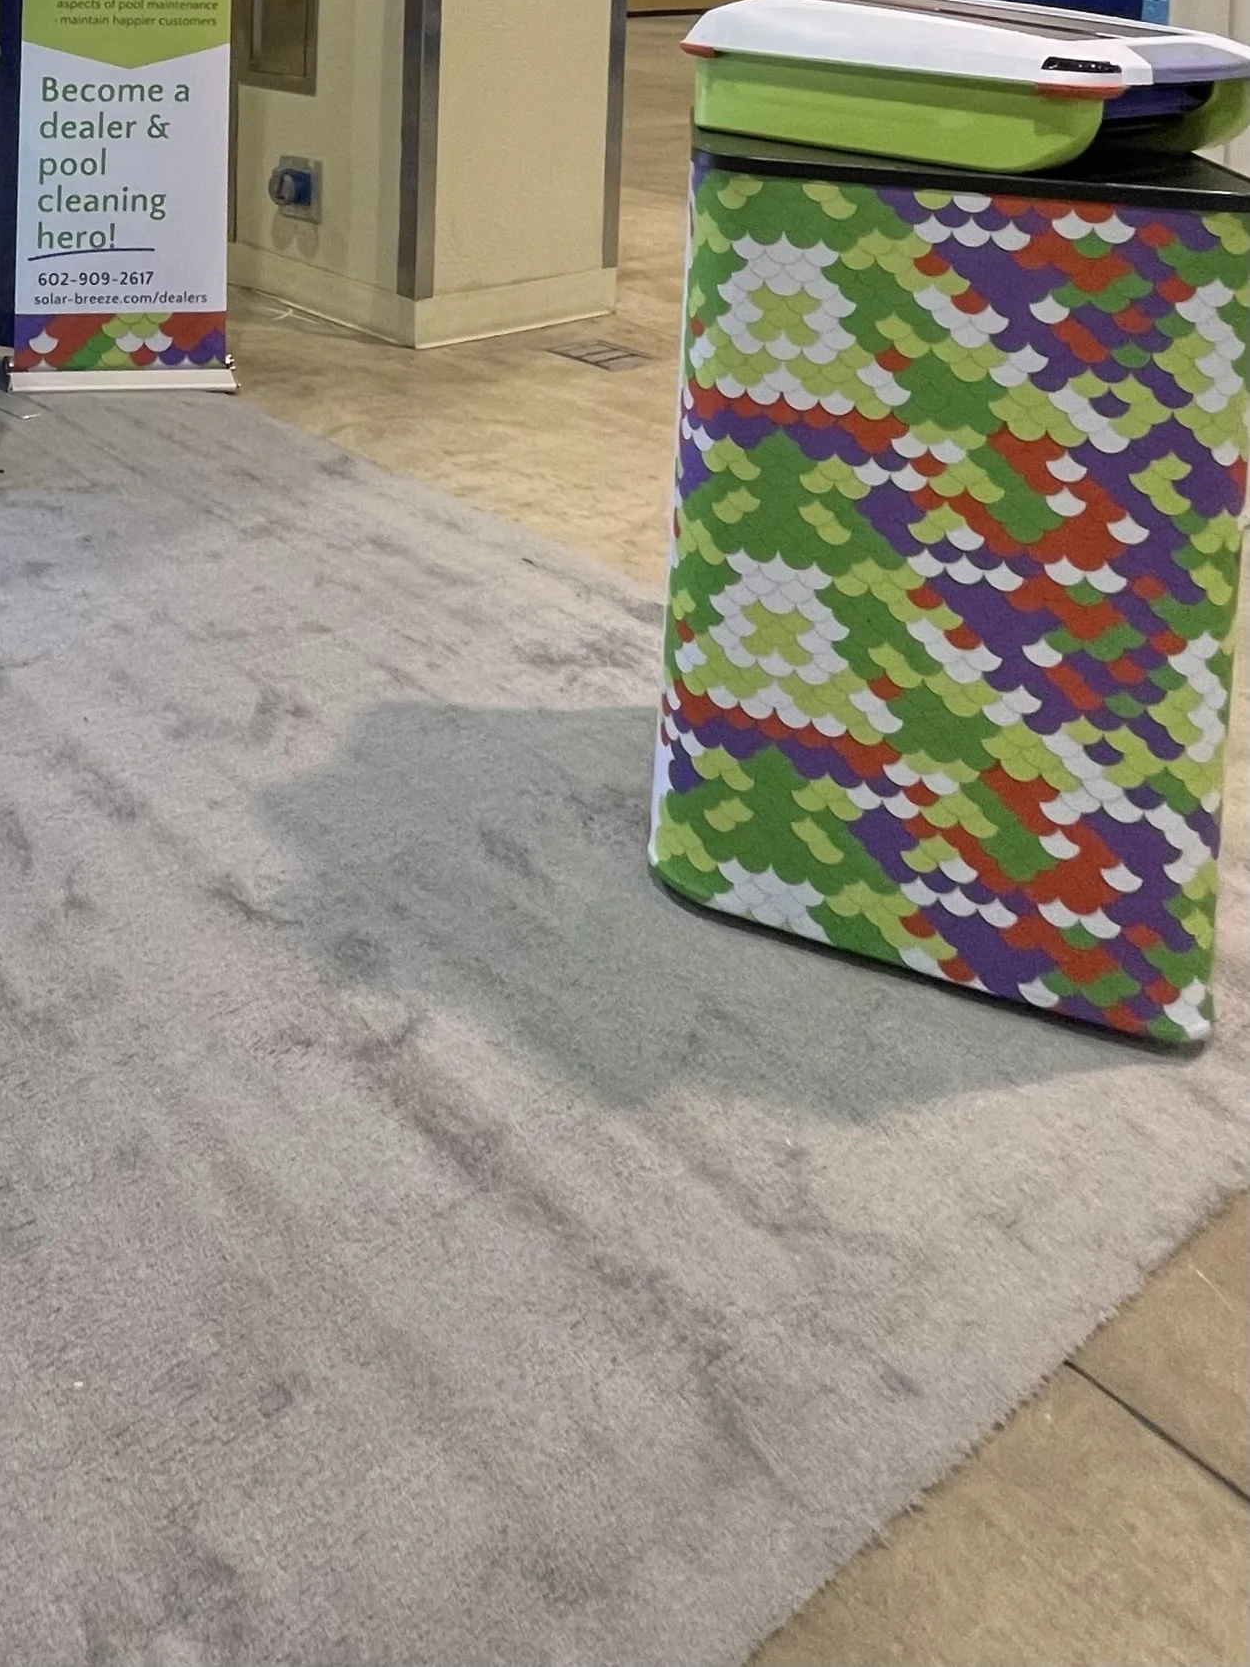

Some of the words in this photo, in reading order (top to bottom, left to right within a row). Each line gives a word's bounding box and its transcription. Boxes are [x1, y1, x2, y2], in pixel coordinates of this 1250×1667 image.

[56, 0, 101, 12] aspects
[104, 0, 117, 10] of
[118, 0, 144, 12] pool
[146, 0, 219, 11] maintenance
[60, 15, 110, 26] maintain
[112, 15, 156, 29] happier
[158, 16, 218, 27] customers
[41, 76, 164, 103] Become
[174, 84, 191, 103] a
[39, 111, 137, 139] dealer
[147, 114, 171, 139] &
[38, 148, 107, 184] pool
[37, 184, 167, 221] cleaning
[36, 221, 116, 250] hero!
[37, 270, 155, 287] 602-909-2617
[33, 290, 208, 306] solar-breeze.com/dealers
